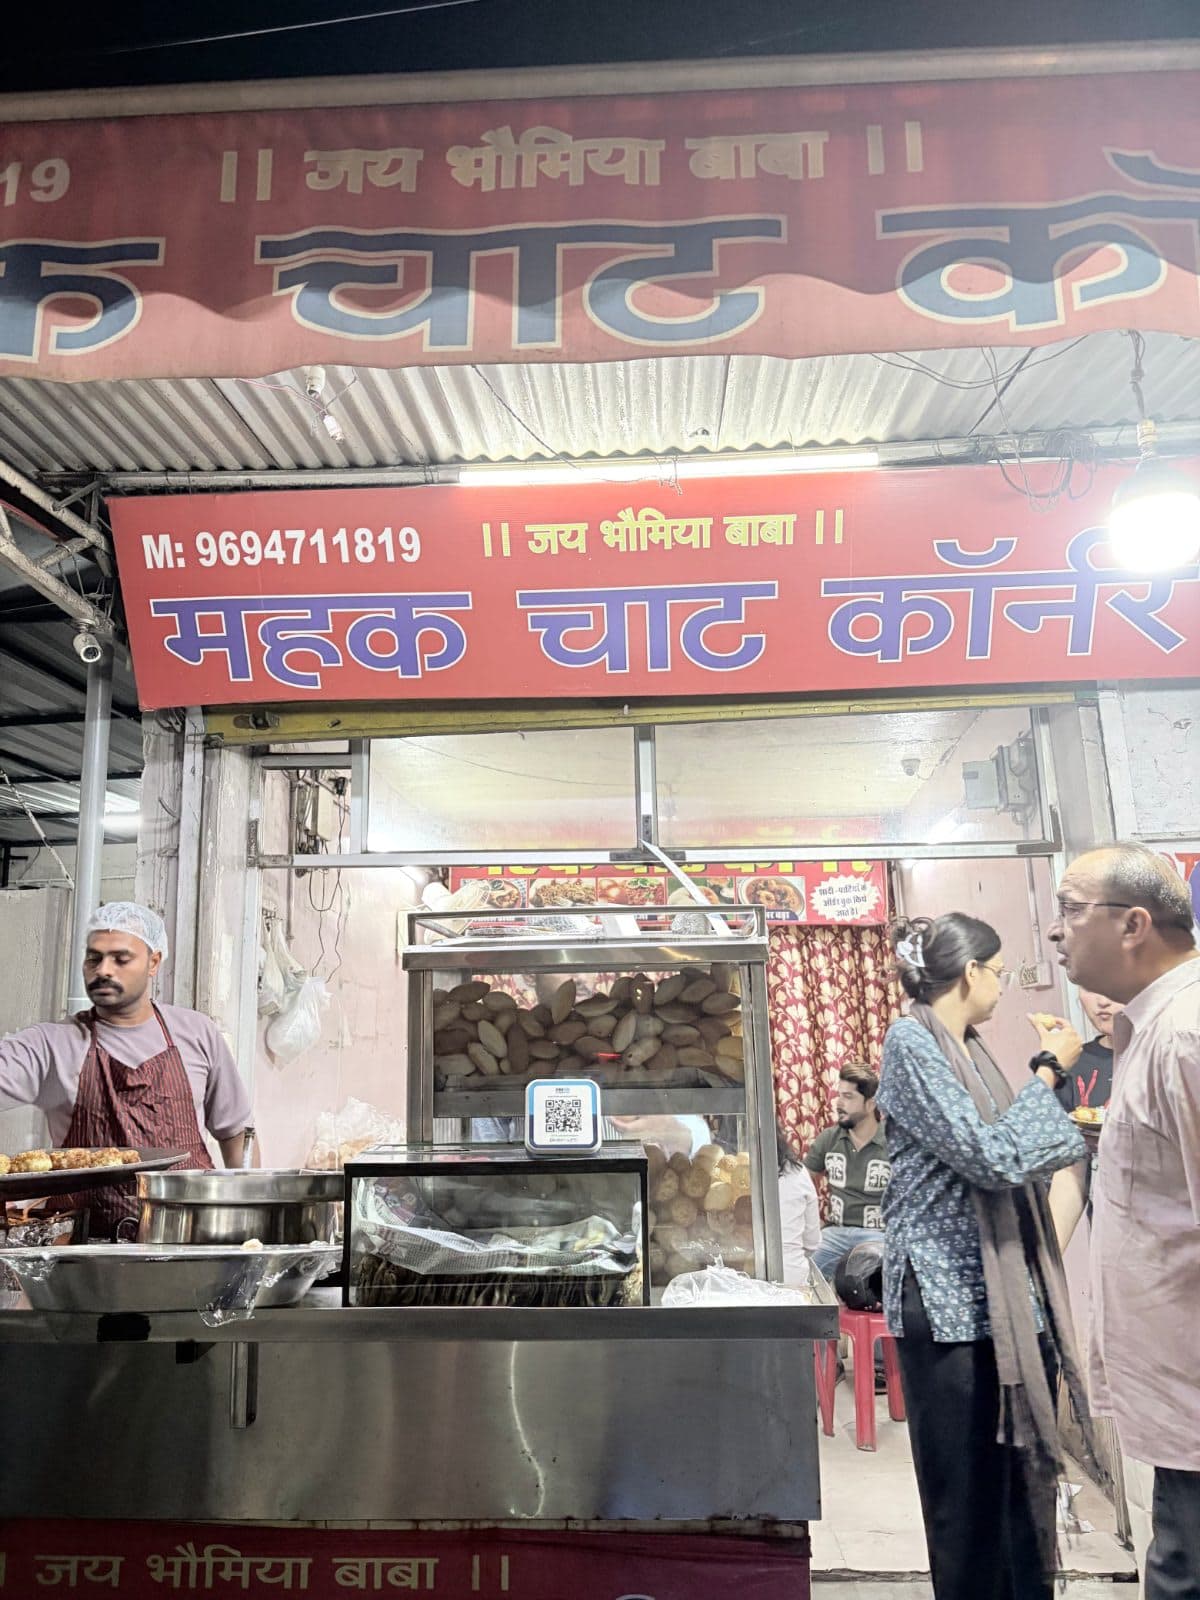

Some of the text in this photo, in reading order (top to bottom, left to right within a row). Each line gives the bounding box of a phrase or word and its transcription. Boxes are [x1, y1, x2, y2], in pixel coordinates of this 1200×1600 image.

[304, 149, 423, 193] जय
[686, 131, 828, 180] बाबा
[254, 218, 788, 352] चाट
[141, 526, 422, 569] M: 9694711819
[525, 522, 588, 555] जय
[723, 514, 796, 547] बाबा
[149, 591, 472, 689] महक
[516, 581, 778, 675] चाट
[34, 1554, 125, 1587] जय
[332, 1556, 440, 1590] बाबा
